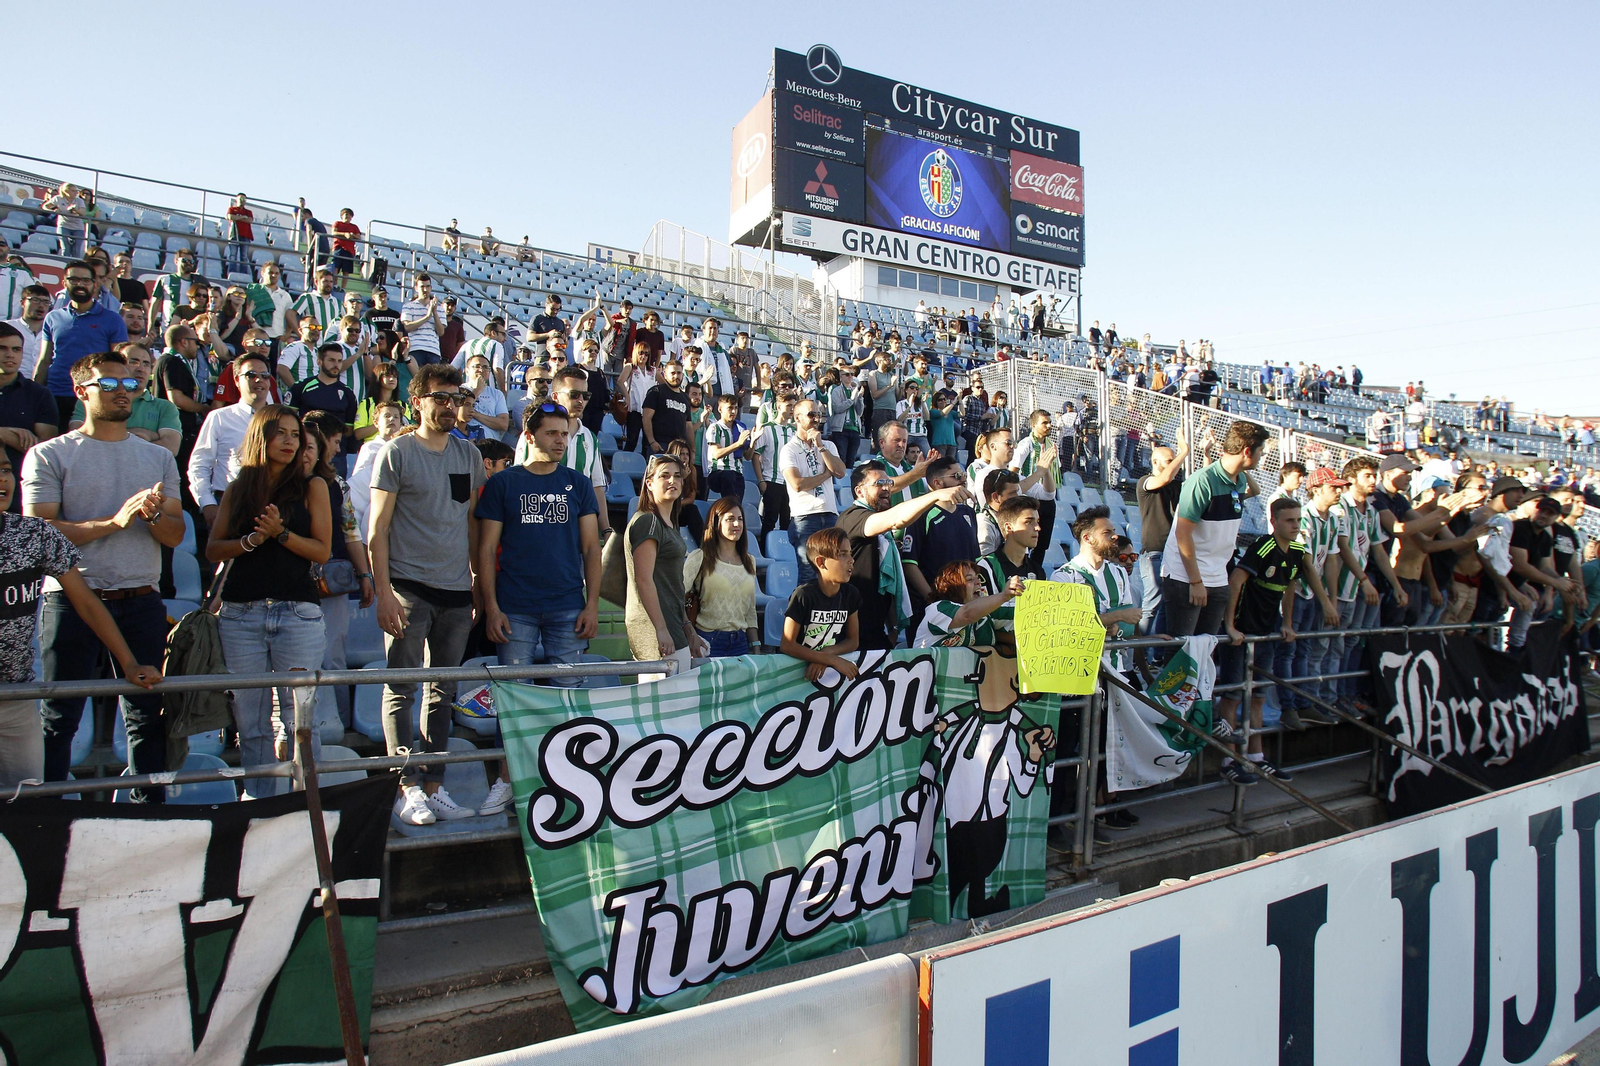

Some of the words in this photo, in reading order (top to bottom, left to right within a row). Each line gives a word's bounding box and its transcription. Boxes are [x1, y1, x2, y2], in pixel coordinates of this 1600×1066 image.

[786, 80, 862, 108] Mercedes-Benz
[793, 104, 842, 130] Selitrac
[892, 83, 1000, 138] Citycar
[1010, 115, 1058, 152] Sur
[824, 131, 832, 139] by
[832, 133, 855, 144] Selicars
[917, 127, 963, 146] arasport.es
[795, 141, 847, 157] www.selitrac.com
[1014, 165, 1079, 201] Coca-Cola
[805, 193, 839, 206] MITSUBISHI
[810, 202, 835, 212] MOTORS
[900, 215, 942, 233] ¡GRACIAS
[943, 223, 980, 241] AFICIÓN!
[1036, 221, 1080, 242] smart
[785, 237, 817, 248] SEAT
[842, 229, 908, 261] GRAN
[917, 242, 1000, 277] CENTRO
[1006, 260, 1077, 293] GETAFE
[521, 514, 544, 524] ASICS
[529, 649, 939, 848] Sección
[577, 784, 941, 1015] Juvenil
